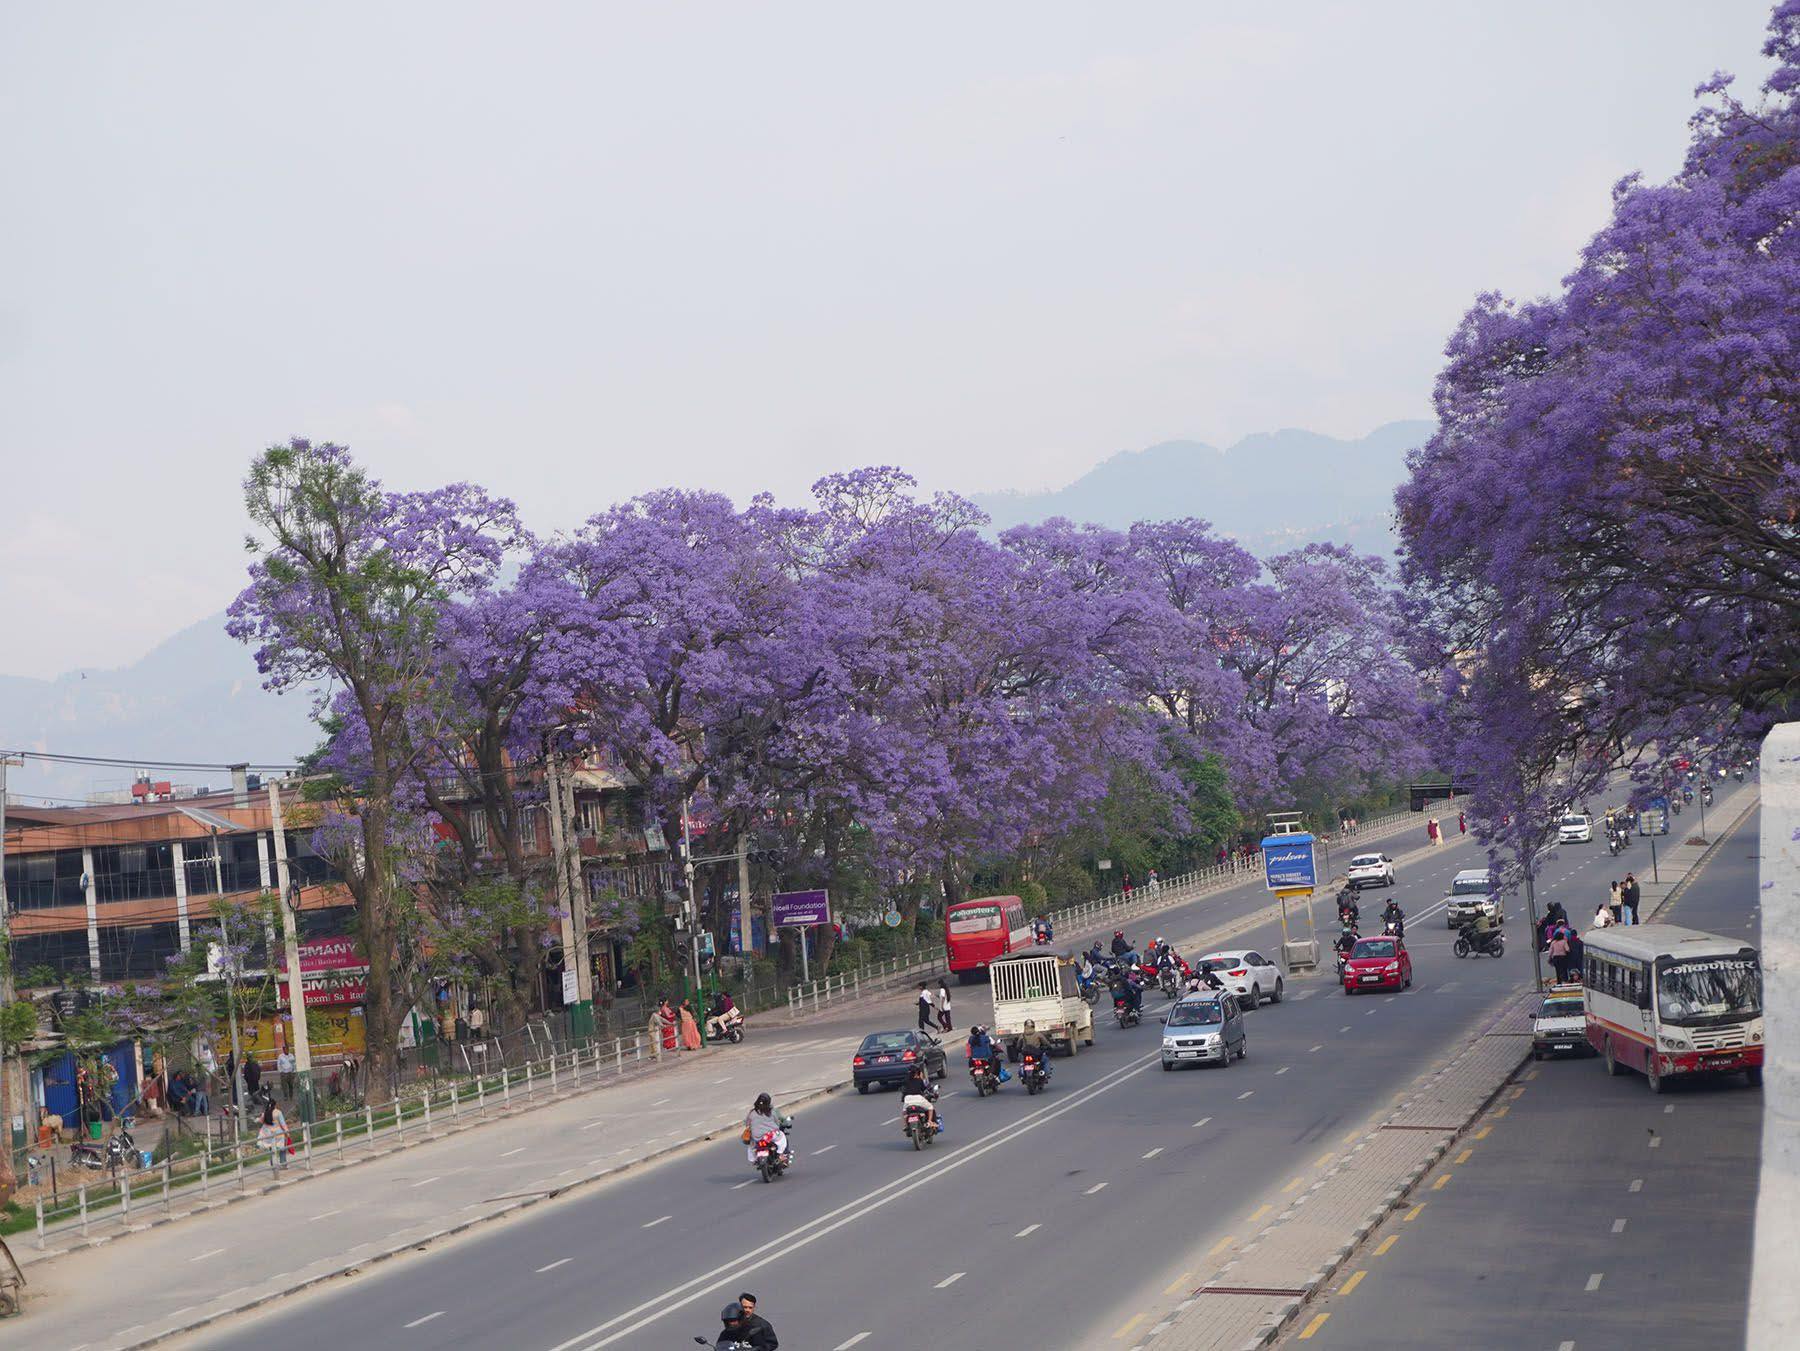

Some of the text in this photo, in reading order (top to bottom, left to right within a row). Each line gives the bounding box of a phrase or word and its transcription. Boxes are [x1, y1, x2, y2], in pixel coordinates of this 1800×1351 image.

[790, 901, 826, 911] Foundation
[298, 943, 359, 957] OMANY
[301, 976, 366, 992] OMANY
